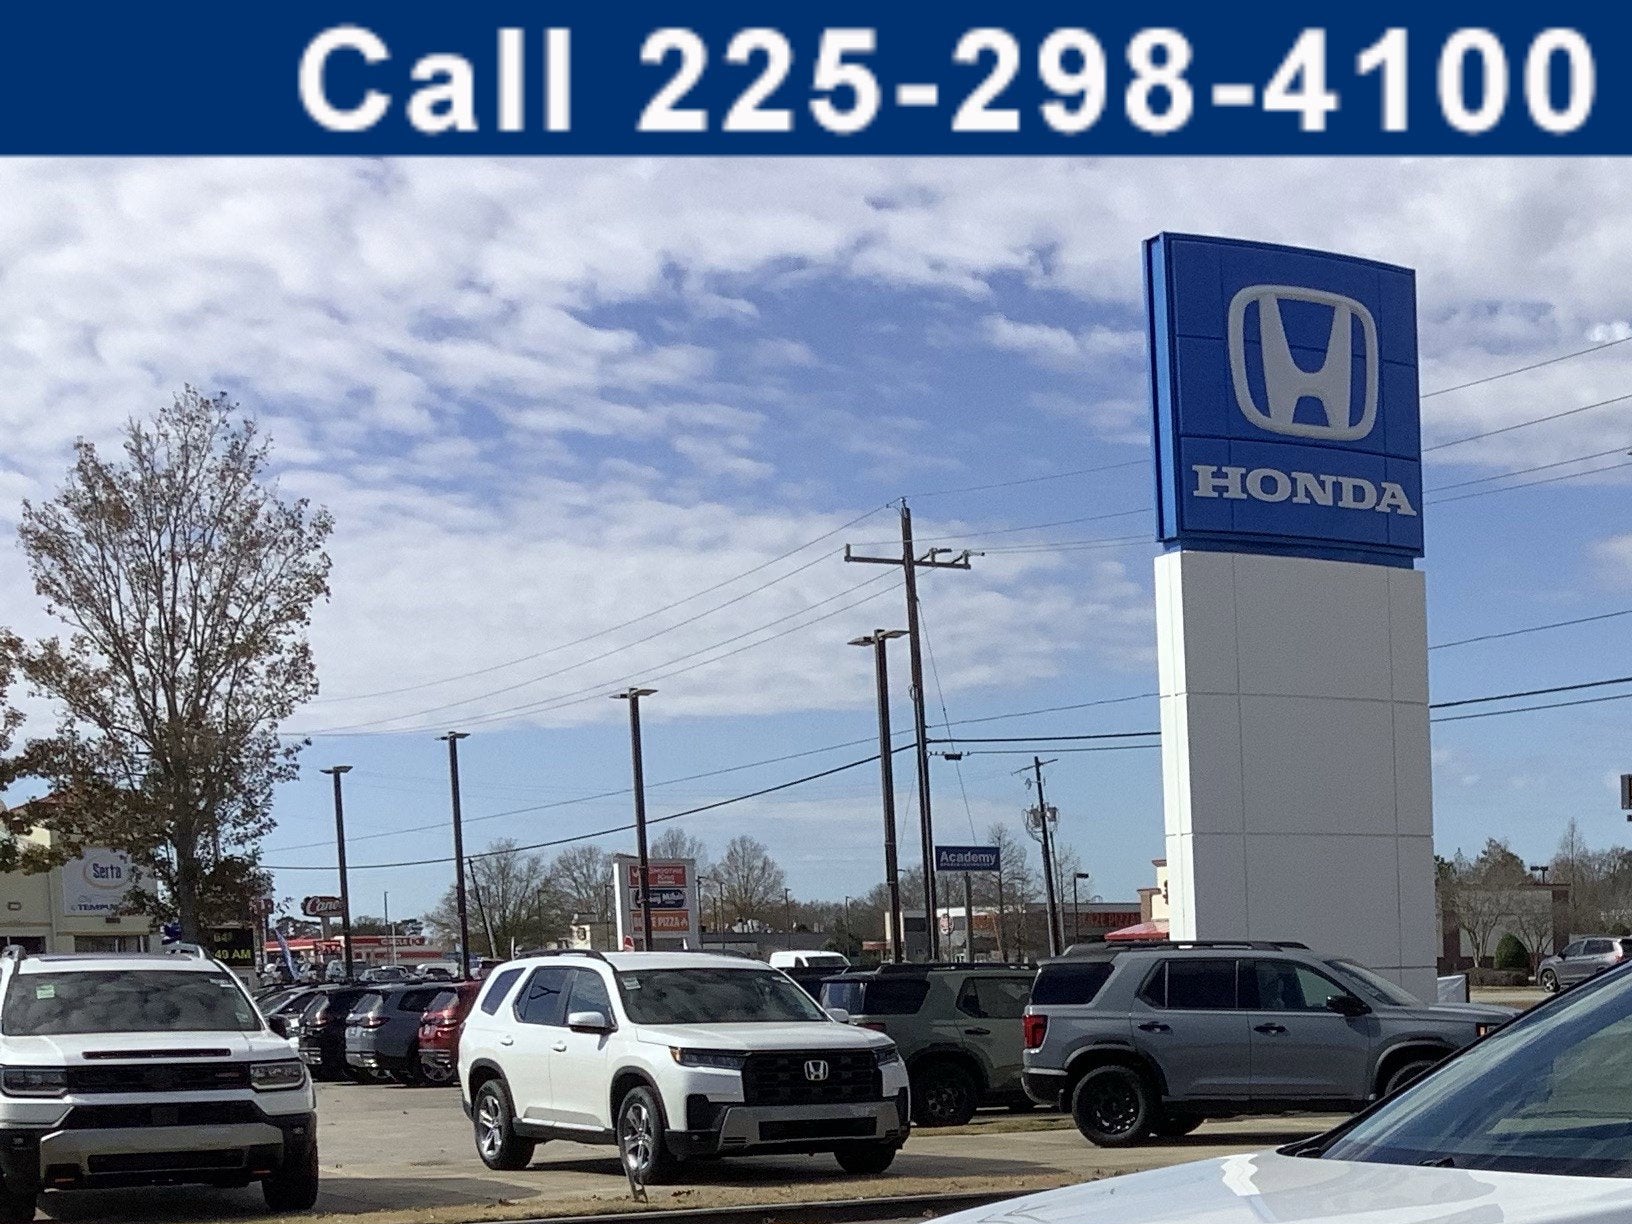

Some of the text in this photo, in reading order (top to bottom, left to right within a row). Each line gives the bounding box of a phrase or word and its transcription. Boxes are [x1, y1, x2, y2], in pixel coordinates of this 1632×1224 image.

[1192, 464, 1417, 517] HONDA
[940, 851, 996, 866] Academy
[92, 862, 122, 880] Serta
